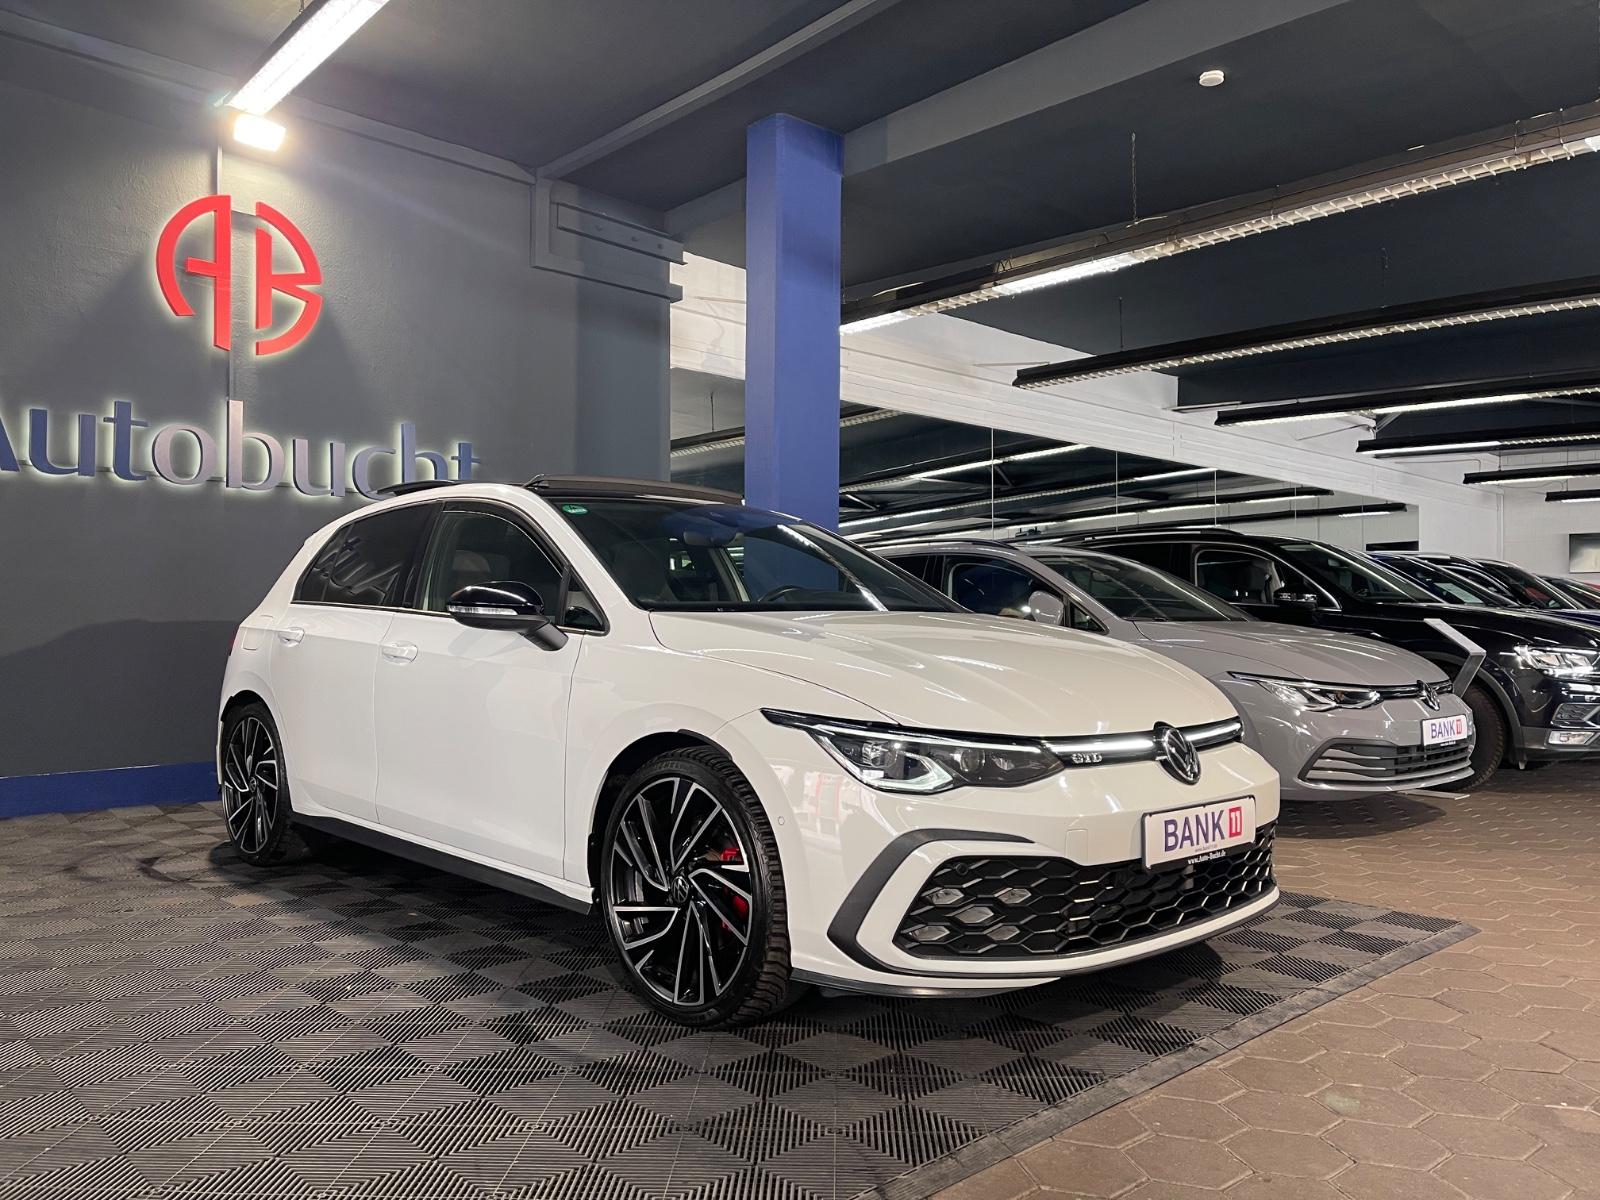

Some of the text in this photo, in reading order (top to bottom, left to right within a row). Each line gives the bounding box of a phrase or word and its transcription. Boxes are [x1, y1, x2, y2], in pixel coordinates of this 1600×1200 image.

[155, 194, 324, 357] AB
[1430, 720, 1456, 739] BANK
[1163, 808, 1242, 853] BANK 11
